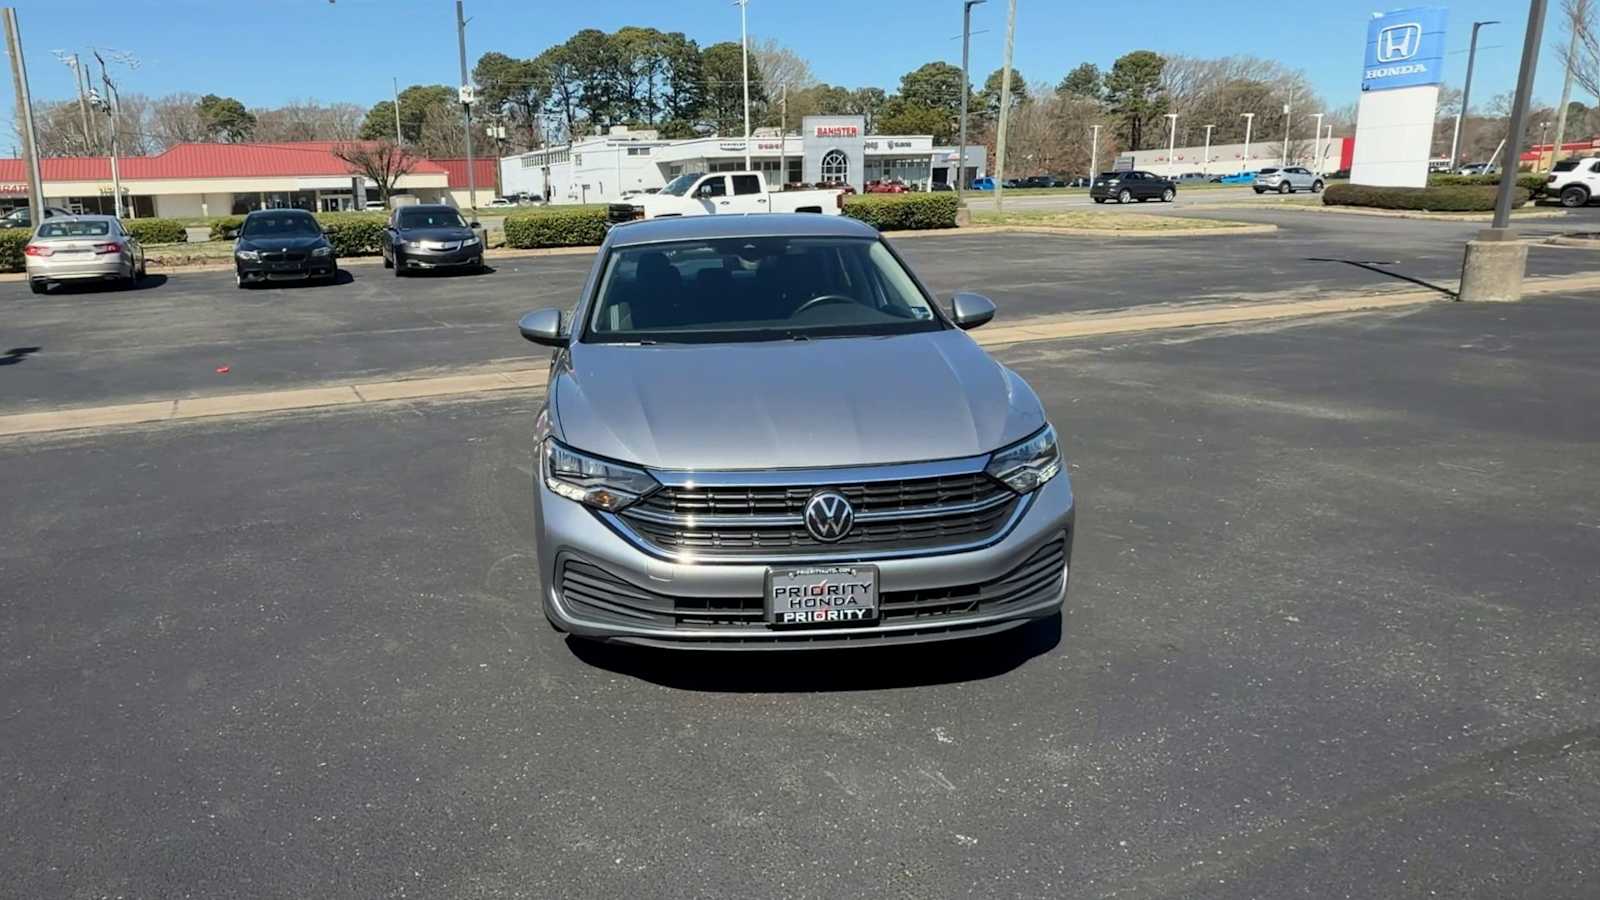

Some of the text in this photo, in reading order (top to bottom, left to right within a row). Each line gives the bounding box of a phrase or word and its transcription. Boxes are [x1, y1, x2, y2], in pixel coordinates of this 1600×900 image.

[1366, 64, 1426, 79] HONDA
[816, 126, 857, 137] BANISTER
[774, 581, 872, 598] PRIORITY
[790, 596, 858, 609] HONDA
[784, 608, 866, 623] PRIORITY
